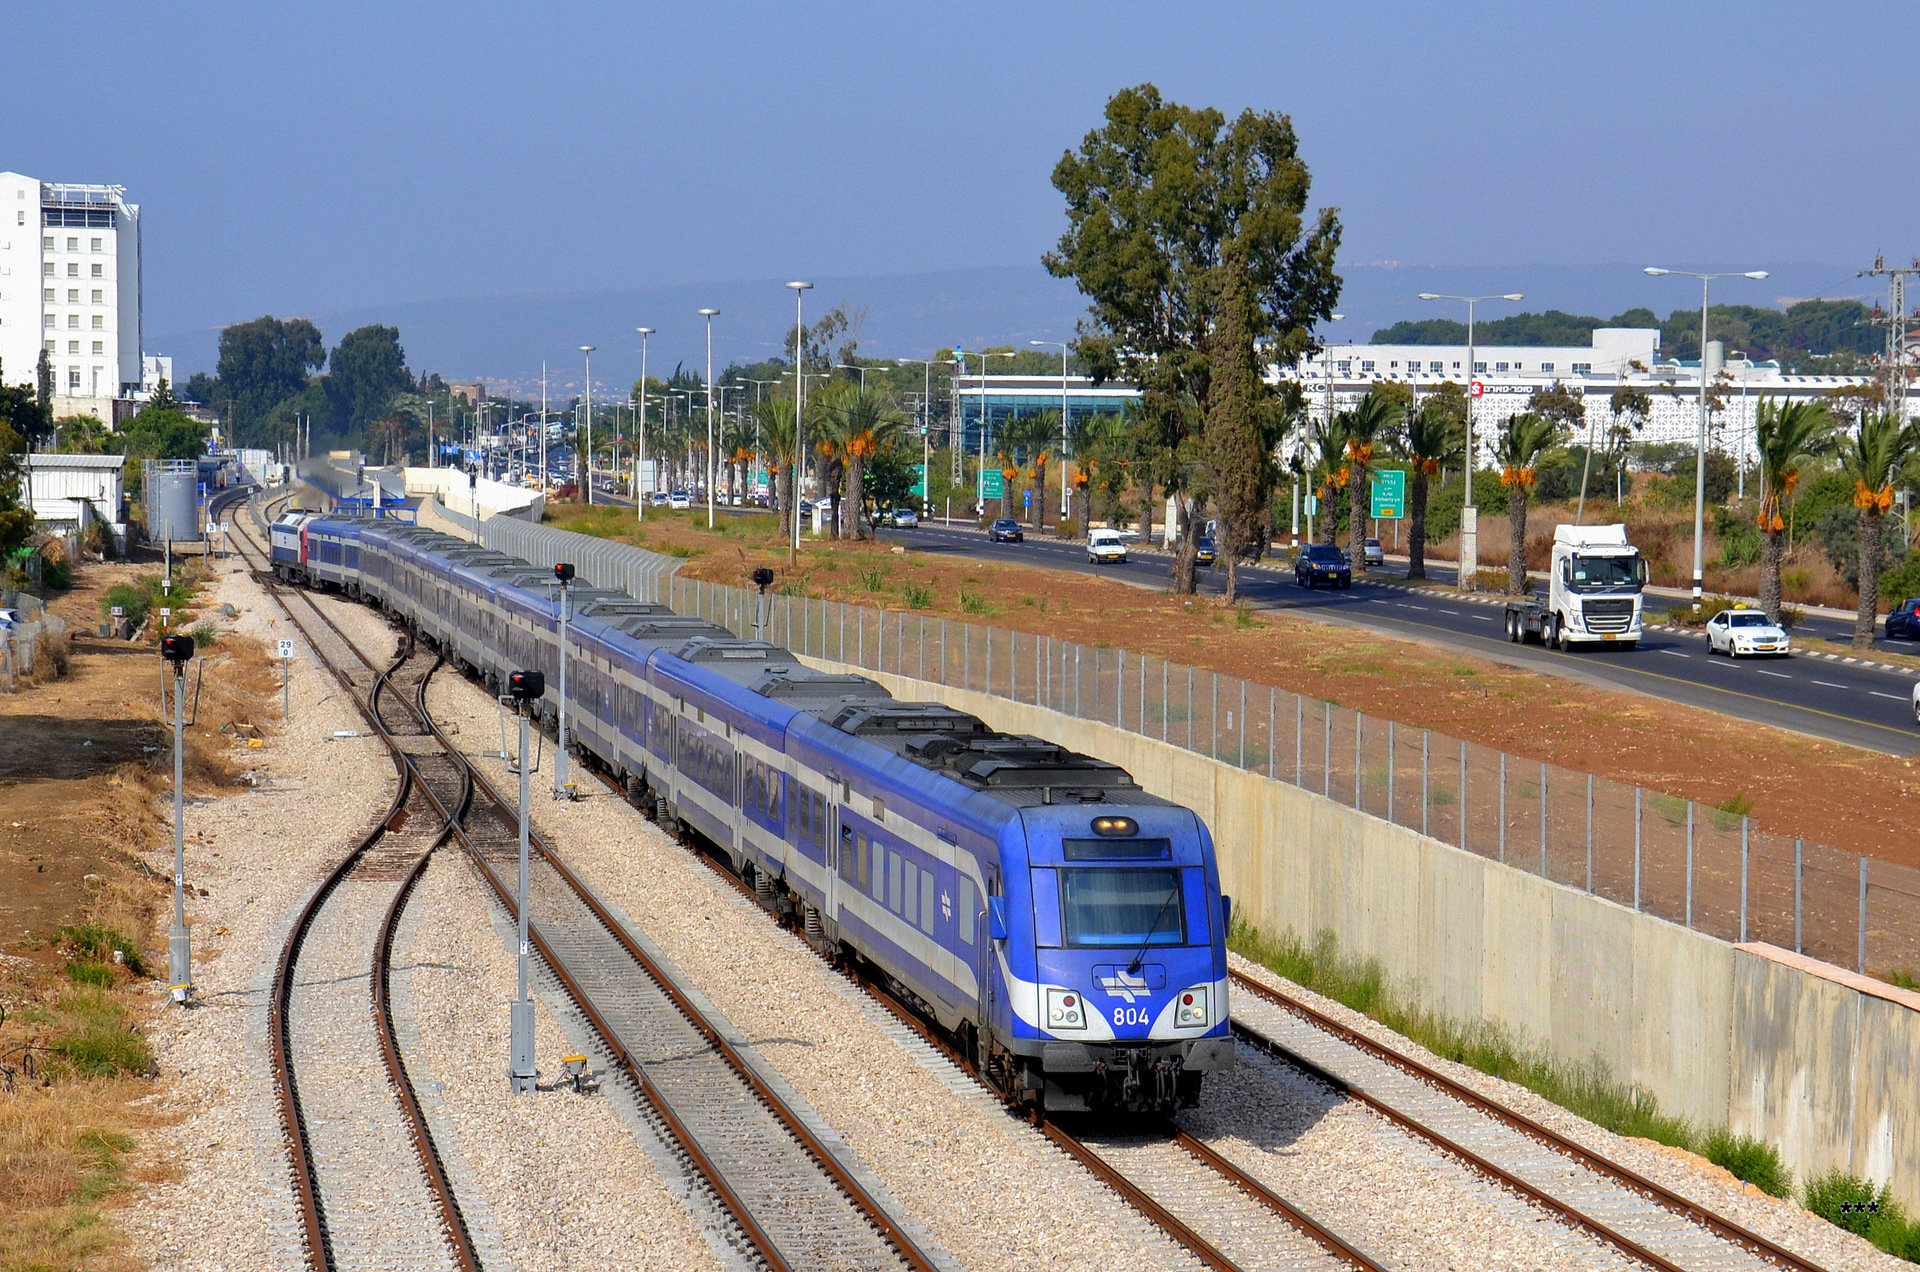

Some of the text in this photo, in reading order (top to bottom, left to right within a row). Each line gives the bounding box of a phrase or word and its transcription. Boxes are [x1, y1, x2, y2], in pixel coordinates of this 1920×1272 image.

[1483, 385, 1534, 394] סופר-פארם
[280, 640, 292, 649] 29
[1113, 1007, 1150, 1026] 804
